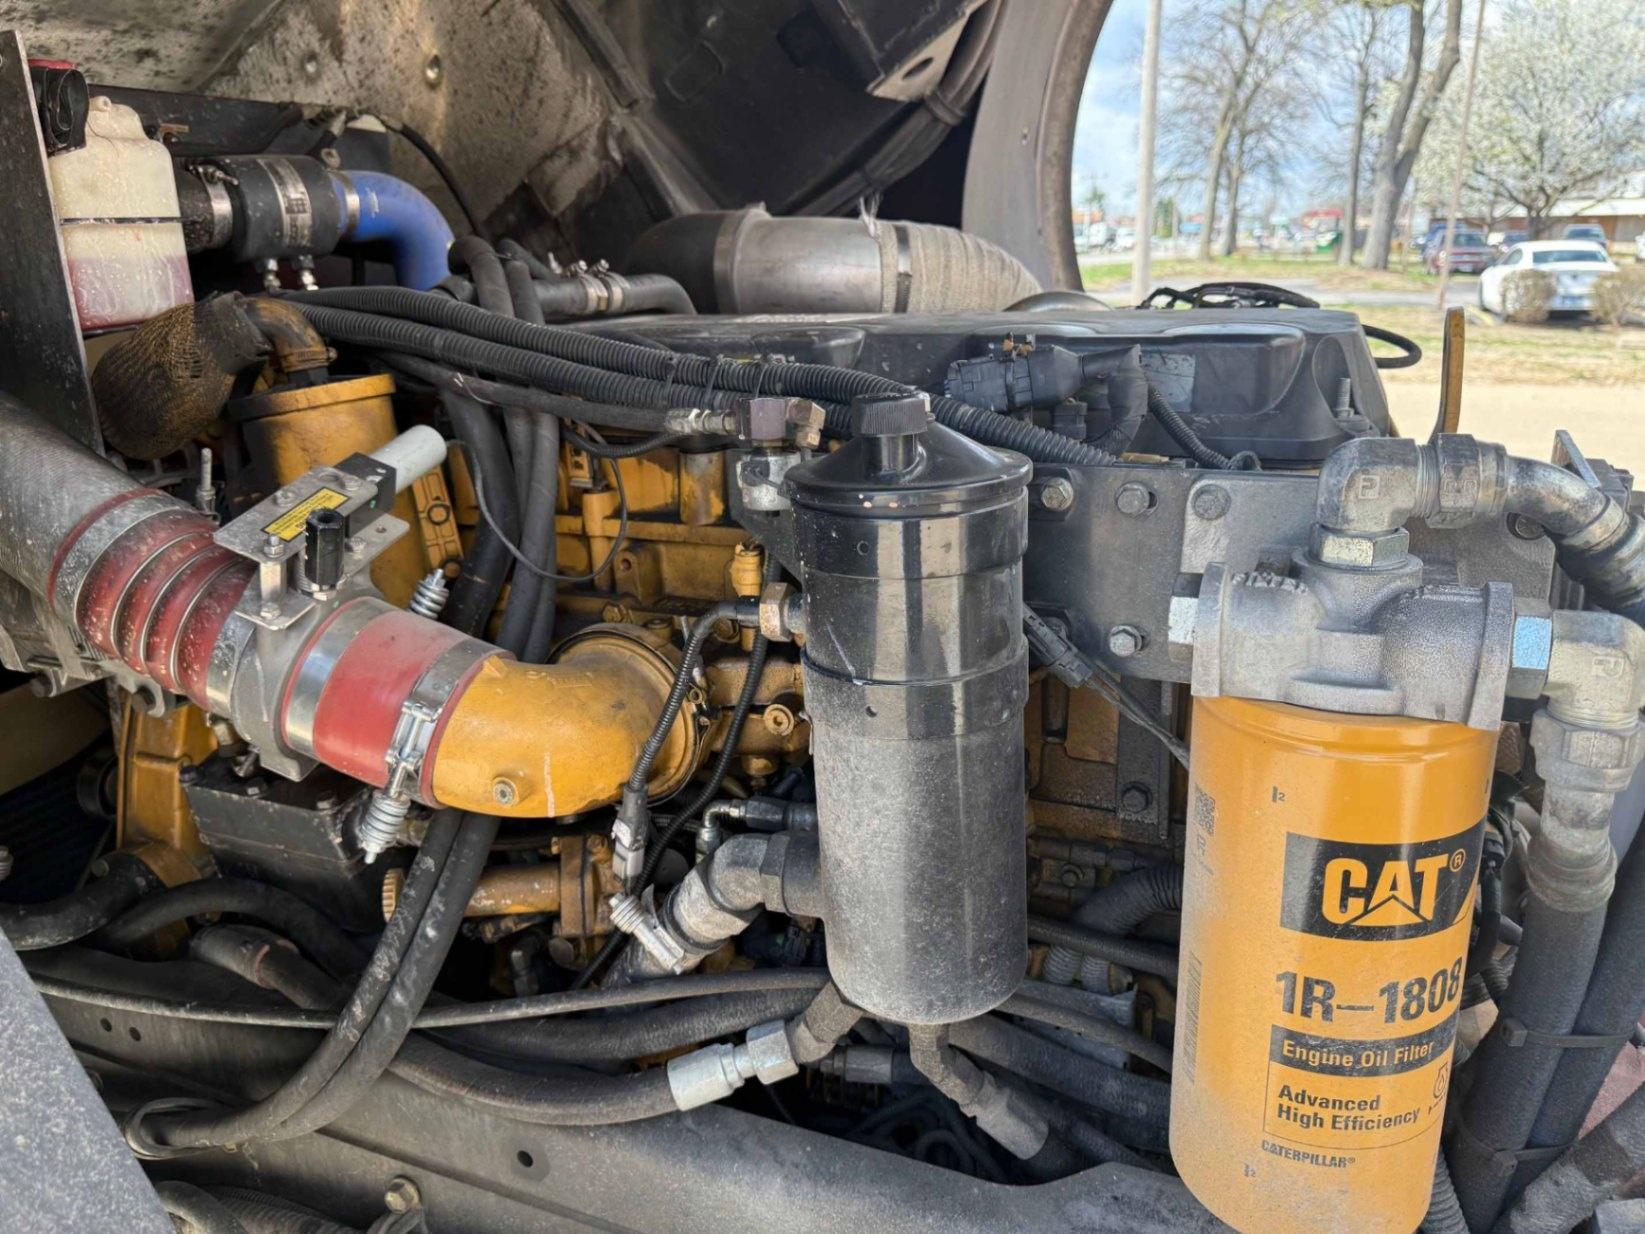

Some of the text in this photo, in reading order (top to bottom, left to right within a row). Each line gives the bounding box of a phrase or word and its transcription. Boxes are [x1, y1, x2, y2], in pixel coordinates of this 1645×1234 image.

[1281, 1039, 1435, 1068] Engine Oil Filter
[1278, 1084, 1382, 1112] Advanced
[1277, 1103, 1421, 1132] High Efficiency
